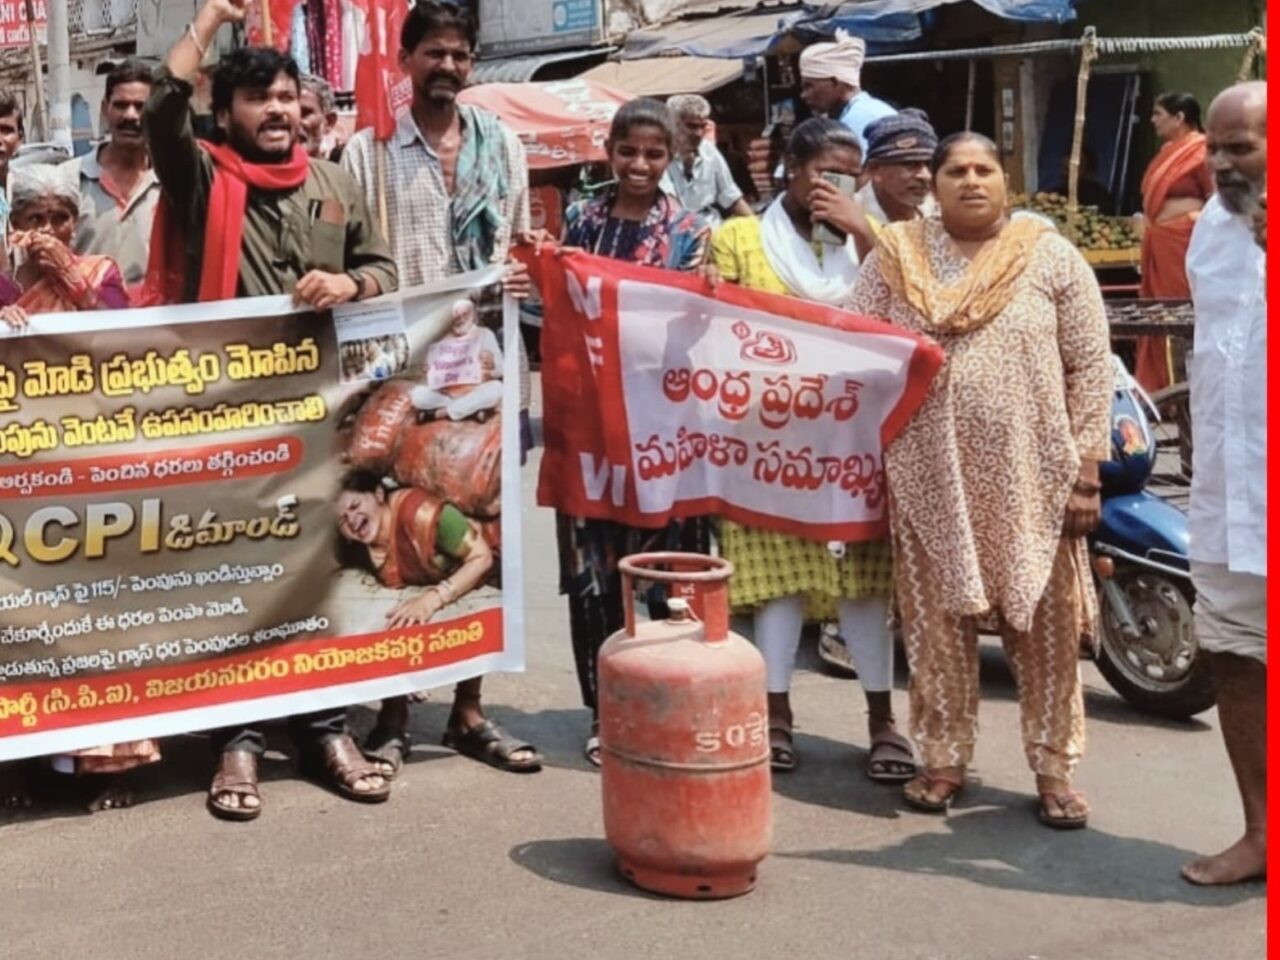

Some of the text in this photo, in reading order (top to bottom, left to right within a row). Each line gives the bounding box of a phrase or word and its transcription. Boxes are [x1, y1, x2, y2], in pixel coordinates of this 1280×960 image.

[23, 354, 95, 397] మోడి
[100, 348, 220, 397] ప్రభుత్వం
[225, 338, 320, 383] మోపిన
[62, 409, 138, 447] వెంటనే
[140, 394, 327, 440] ఉపసంహరించాలి
[661, 366, 864, 430] ఆంధ్ర ప్రదేశ్
[90, 456, 149, 484] పెంచిన
[153, 456, 203, 479] ధరలు
[206, 442, 291, 478] తగ్గించండి
[635, 425, 888, 511] మహిళా సమాఖ్య
[23, 493, 301, 564] CPI డిమాండ్
[35, 584, 70, 608] గ్యాస్
[72, 584, 89, 603] పై
[91, 576, 127, 599] 115/-
[131, 571, 192, 592] పెంపును
[117, 610, 155, 631] ధరల
[118, 642, 154, 668] గ్యాస్
[156, 641, 181, 661] ధర
[145, 656, 289, 702] విజయనగరం
[293, 630, 425, 674] నియోజకవర్గ
[428, 620, 485, 655] సమితి
